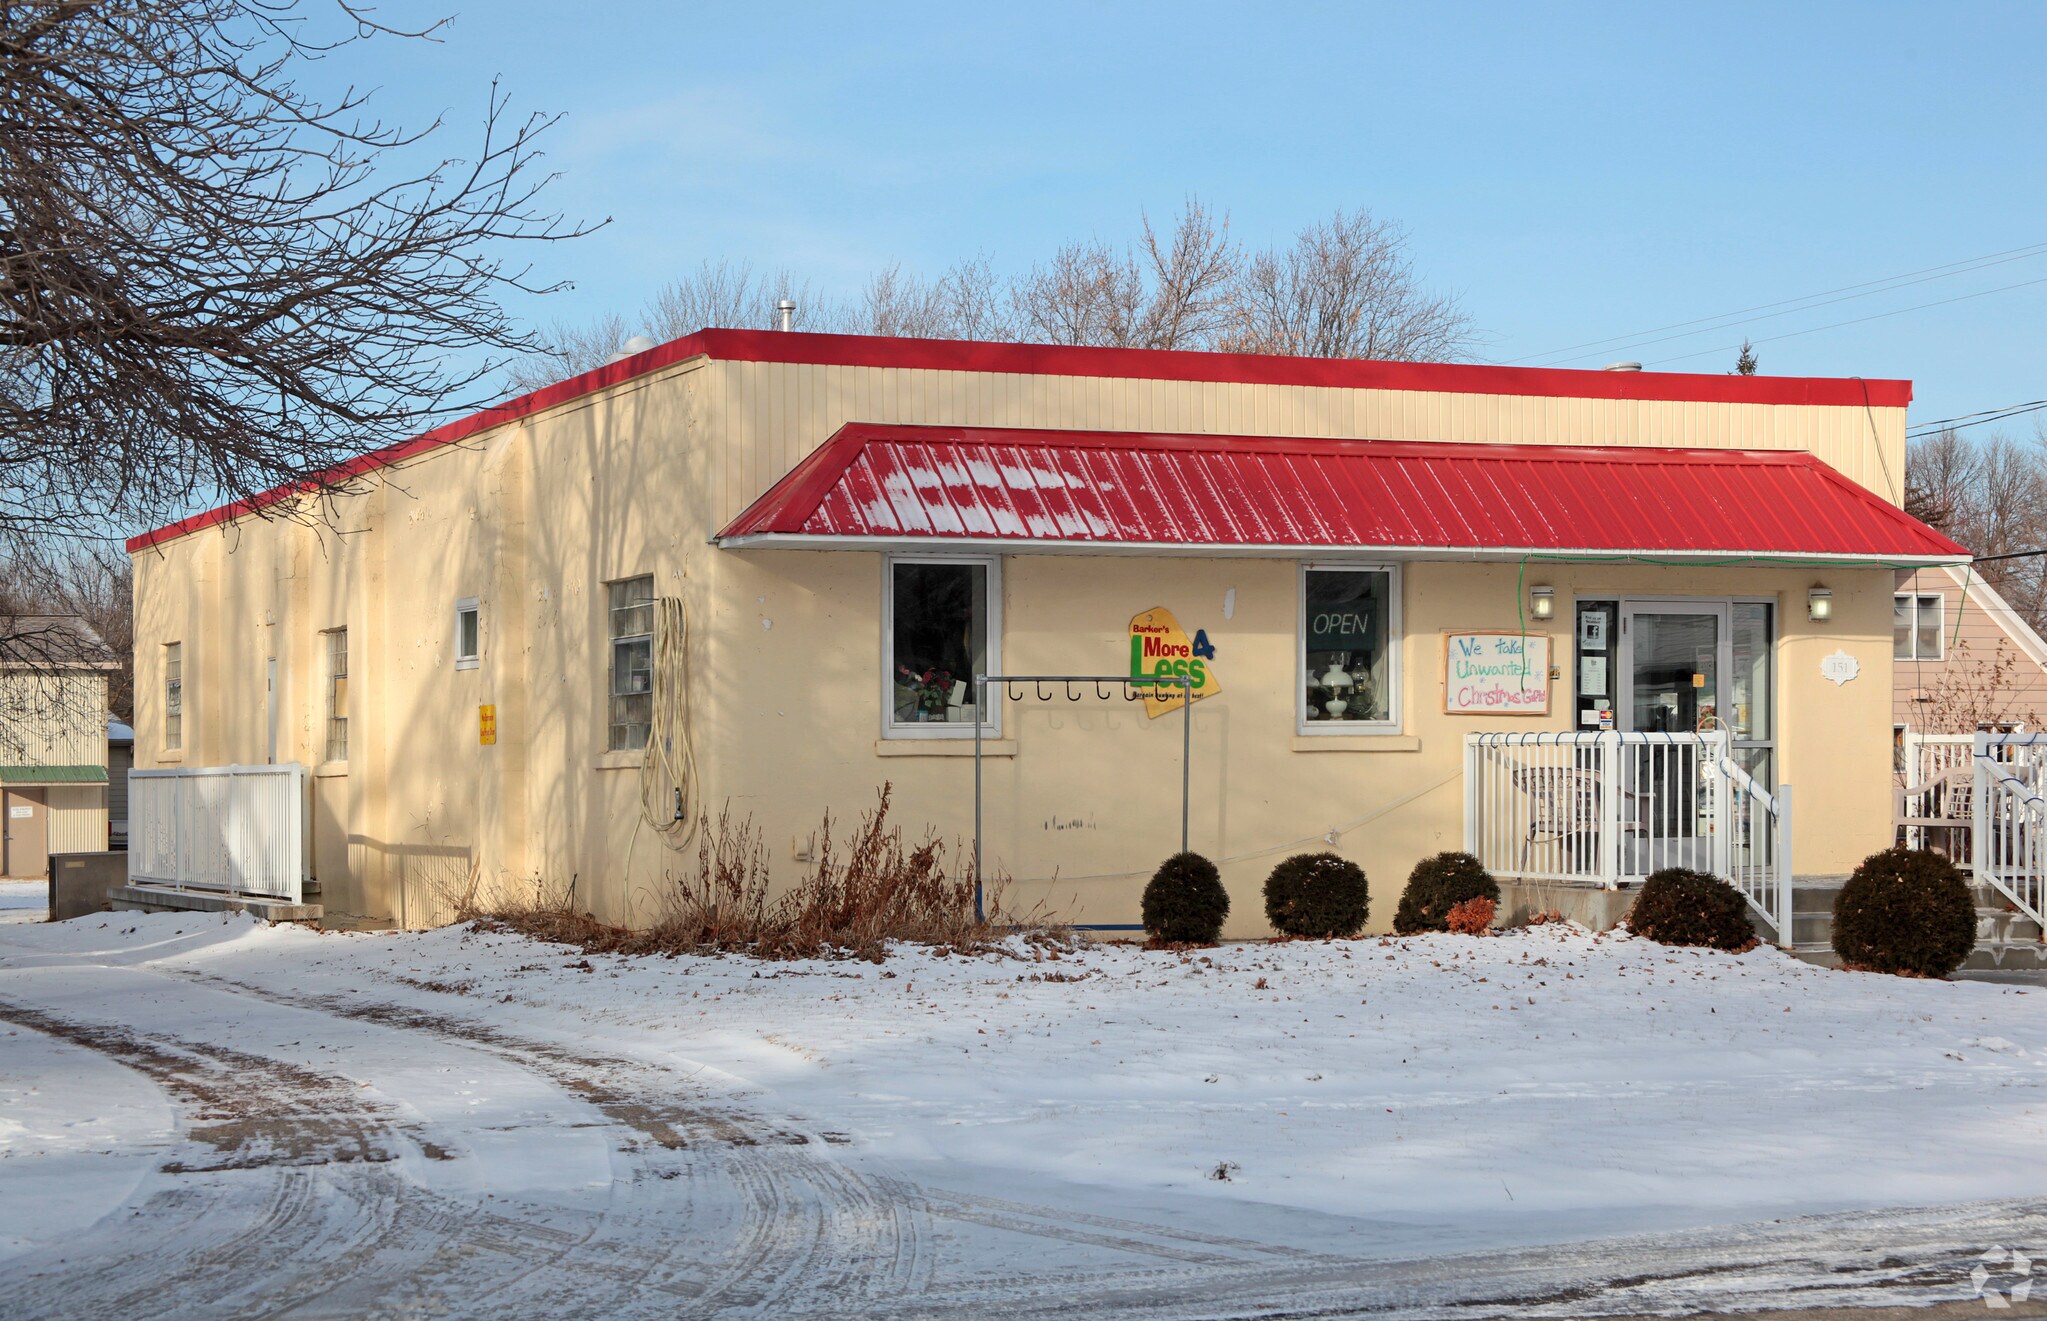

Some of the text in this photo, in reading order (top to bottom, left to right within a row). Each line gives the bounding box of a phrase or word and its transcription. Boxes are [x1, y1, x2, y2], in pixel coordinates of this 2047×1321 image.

[1133, 624, 1170, 634] Barker's
[1313, 613, 1368, 635] OPEN
[1143, 629, 1216, 660] More 4
[1458, 637, 1482, 657] We
[1130, 634, 1206, 689] Less
[1456, 658, 1532, 679] Unwanted
[1832, 662, 1848, 673] 151
